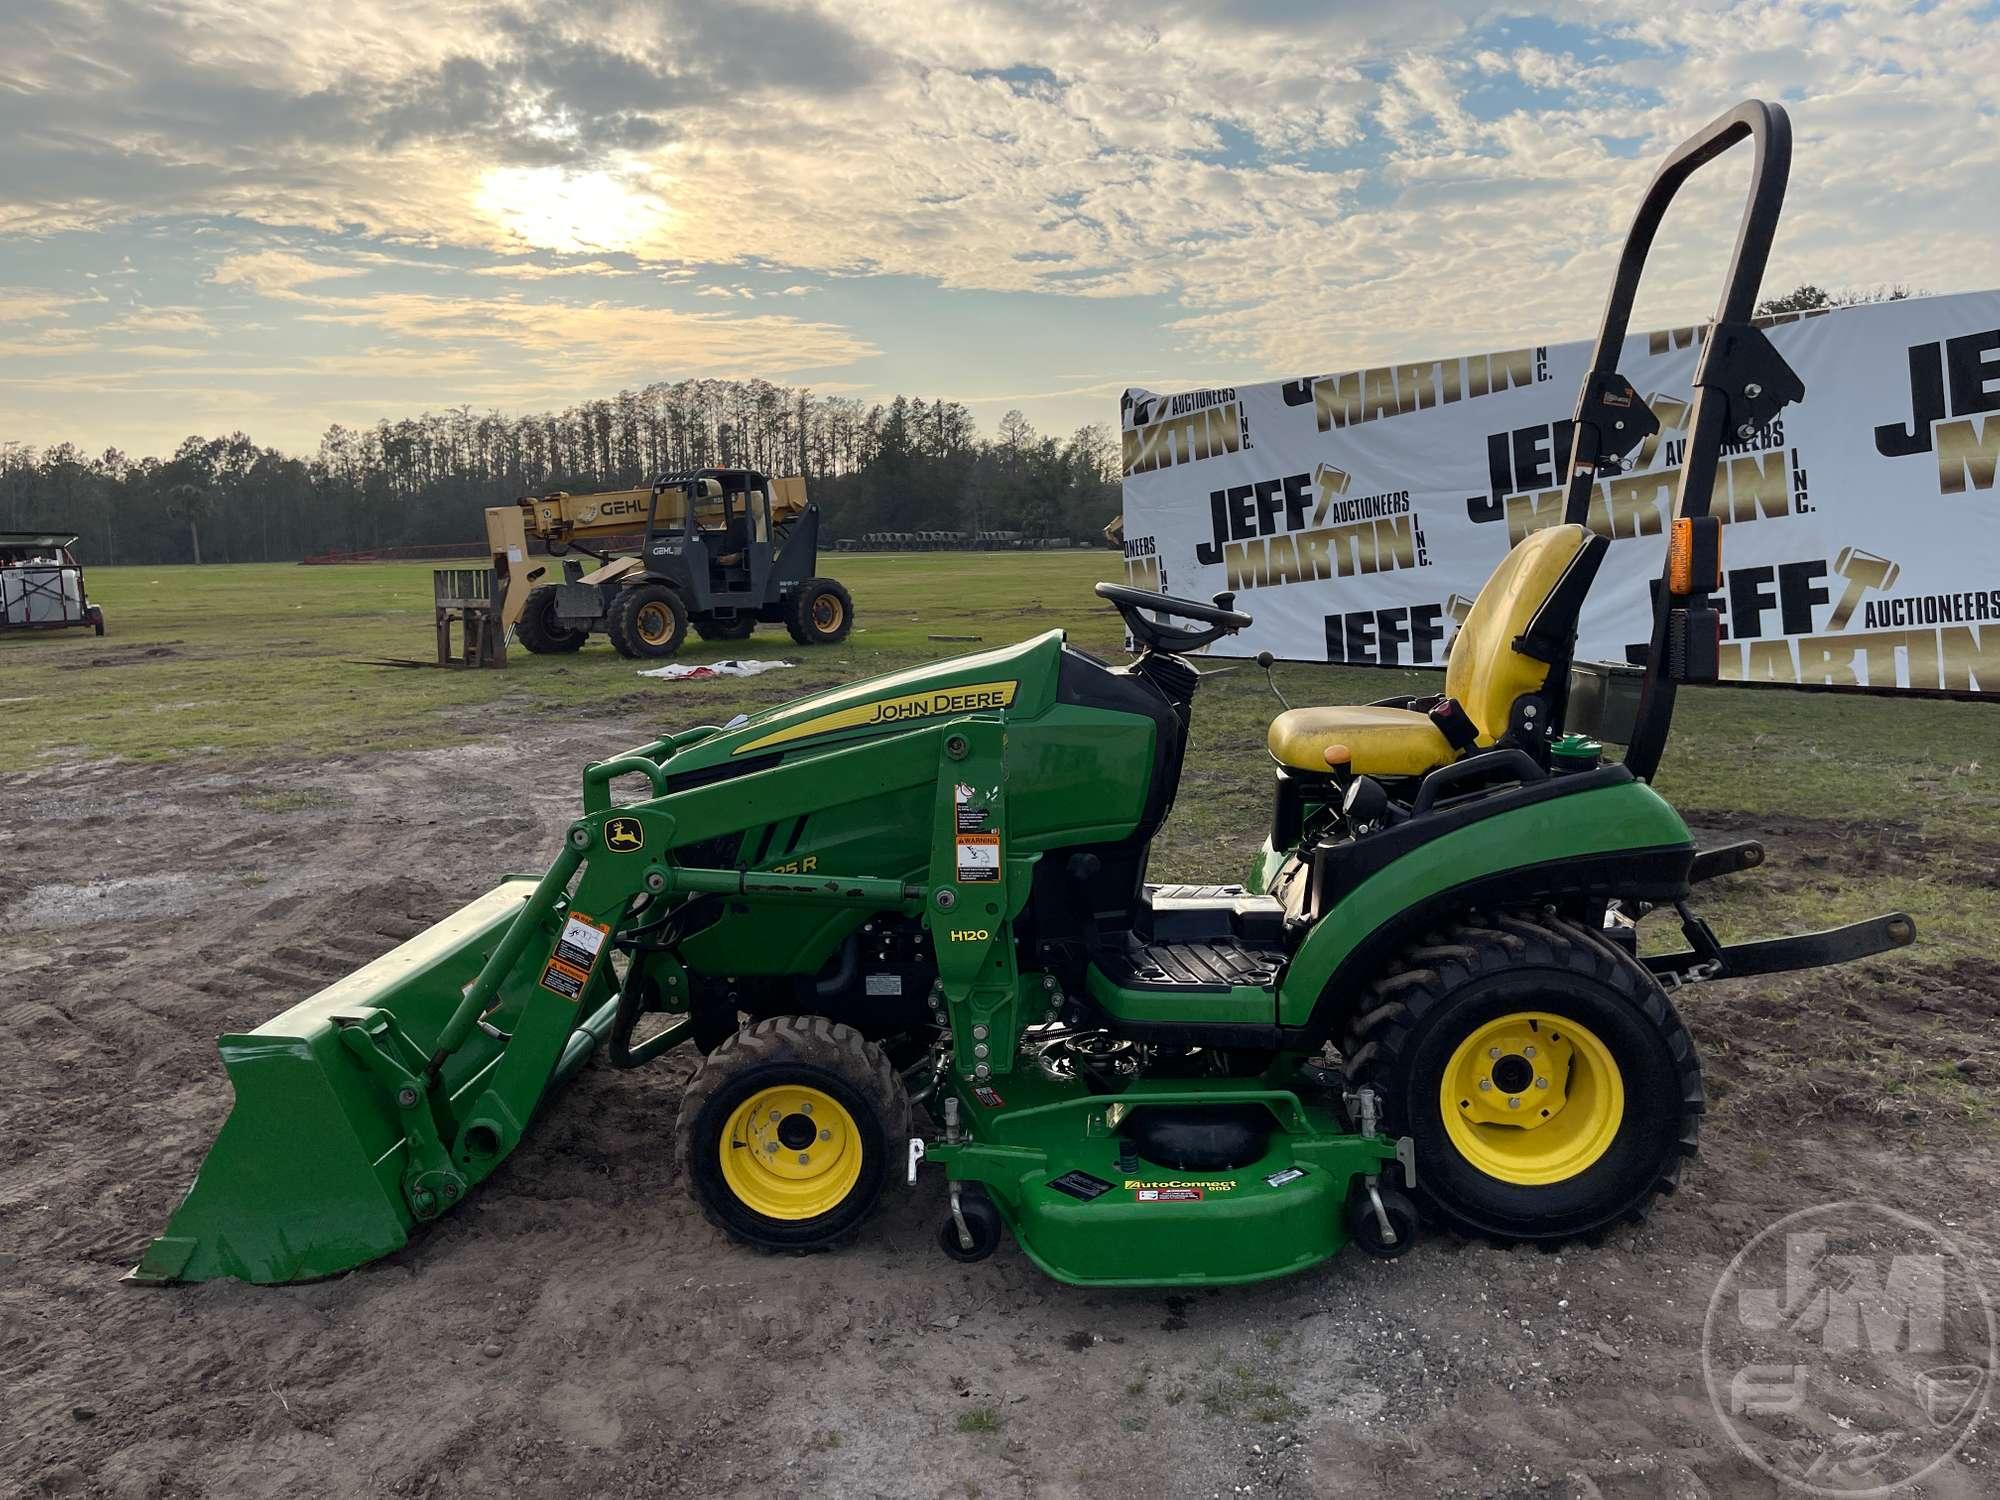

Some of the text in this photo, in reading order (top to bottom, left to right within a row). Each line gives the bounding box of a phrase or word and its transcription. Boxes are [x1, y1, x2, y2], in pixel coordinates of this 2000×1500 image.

[1172, 387, 1236, 416] AUCTIONEERS
[1239, 400, 1254, 450] INC.
[1791, 448, 1816, 514] INC.
[600, 499, 648, 516] GEHL
[1196, 473, 1313, 566] JEFF
[1333, 490, 1410, 525] AUCTIONEERS
[652, 546, 674, 556] GEHL
[1225, 515, 1415, 591] MARTIN
[1414, 513, 1433, 567] INC.
[1865, 590, 2000, 629] AUCTIONEERS
[870, 691, 1004, 722] JOHN DEERE
[951, 929, 988, 942] H120
